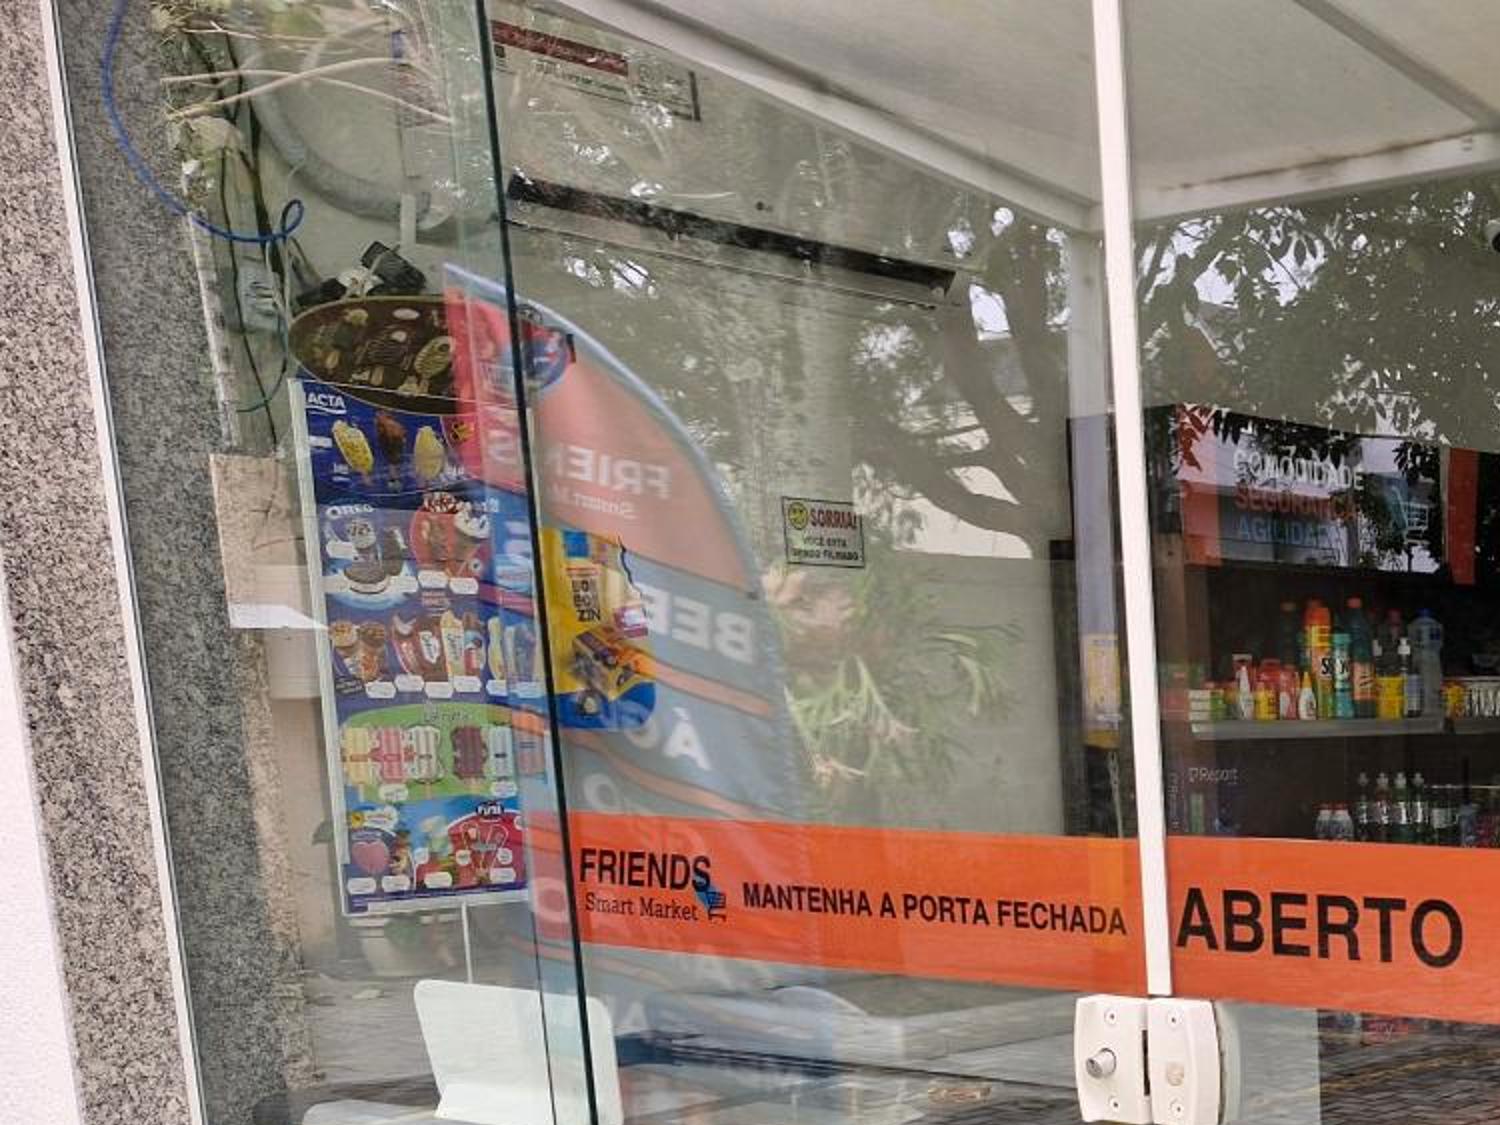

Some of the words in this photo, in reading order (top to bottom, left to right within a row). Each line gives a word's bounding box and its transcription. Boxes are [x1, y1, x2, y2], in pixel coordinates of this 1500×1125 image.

[305, 391, 345, 408] ACTA
[1233, 448, 1365, 491] COMODIDADE
[579, 848, 712, 892] FRIENDS
[584, 891, 636, 918] Smart
[639, 896, 699, 922] Market
[742, 881, 873, 918] MANTENHA
[879, 891, 898, 920] A
[903, 892, 991, 929] PORTA
[997, 900, 1128, 936] FECHADA
[1175, 886, 1465, 970] ABERTO
